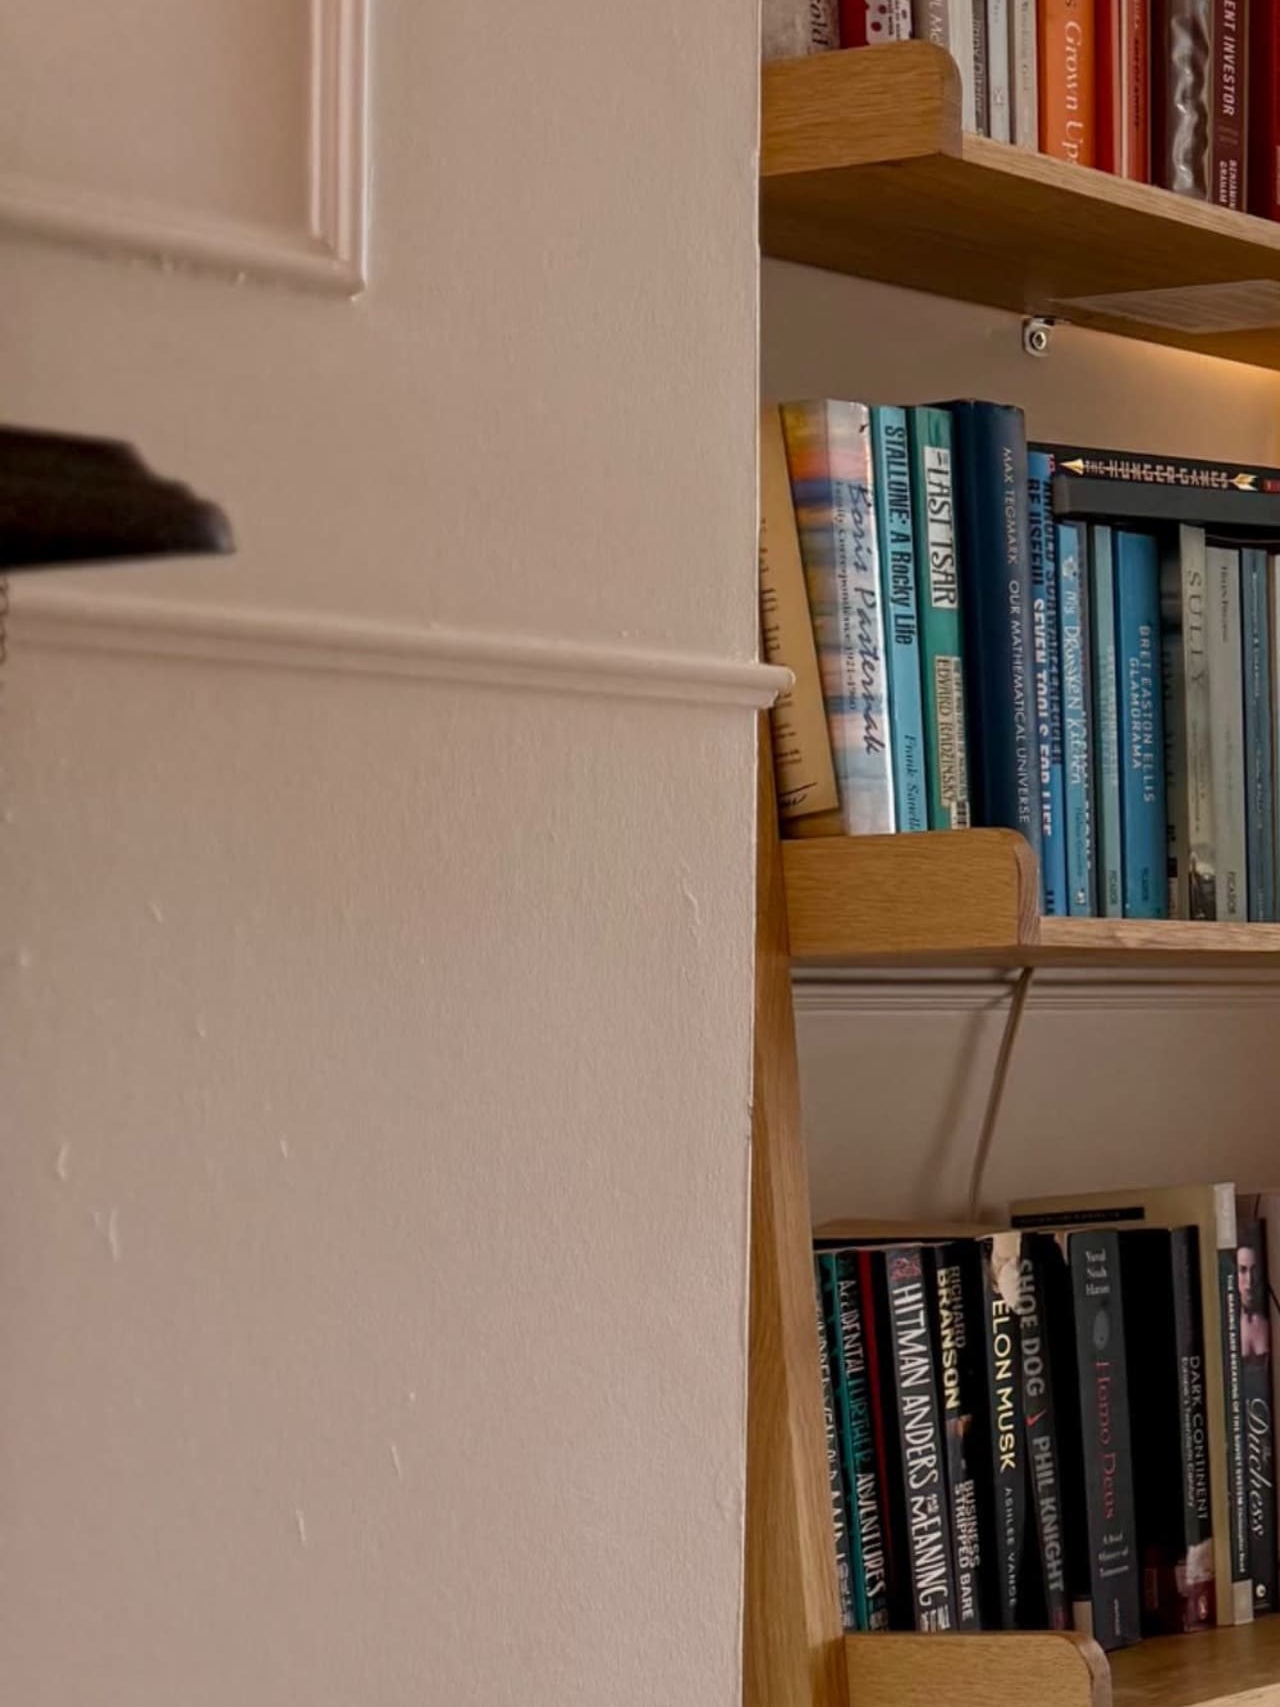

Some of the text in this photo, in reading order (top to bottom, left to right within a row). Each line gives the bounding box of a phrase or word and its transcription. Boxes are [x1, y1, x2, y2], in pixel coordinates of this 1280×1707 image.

[1063, 18, 1084, 111] Grown
[1221, 37, 1236, 117] INVESTOR
[1063, 117, 1086, 167] Ups
[884, 424, 915, 646] STALLONE: A Rocky Life
[928, 467, 957, 606] LAST TSAR
[1109, 459, 1176, 484] HUNGER
[1179, 467, 1229, 489] GAMES
[848, 478, 887, 756] Boris Pasternak
[1002, 447, 1030, 825] MAX TEGMARK OUR MATHEMATICAL UNIVERSE
[1187, 569, 1205, 685] SULLY
[1128, 656, 1142, 770] GLAMORAMA
[1138, 625, 1156, 803] BRET EASTON ELLIS
[935, 1267, 960, 1409] BRANSON
[991, 1299, 1017, 1472] ELON MUSK
[1015, 1257, 1047, 1398] SHOE DOG
[891, 1282, 949, 1607] HITMAN ANDERS MEANING
[1094, 1359, 1114, 1443] Homo
[1188, 1354, 1208, 1520] DARK CONTINENT
[1244, 1397, 1273, 1540] Duchess
[1030, 1435, 1064, 1594] PHIL KNIGHT
[1100, 1451, 1116, 1519] Deus
